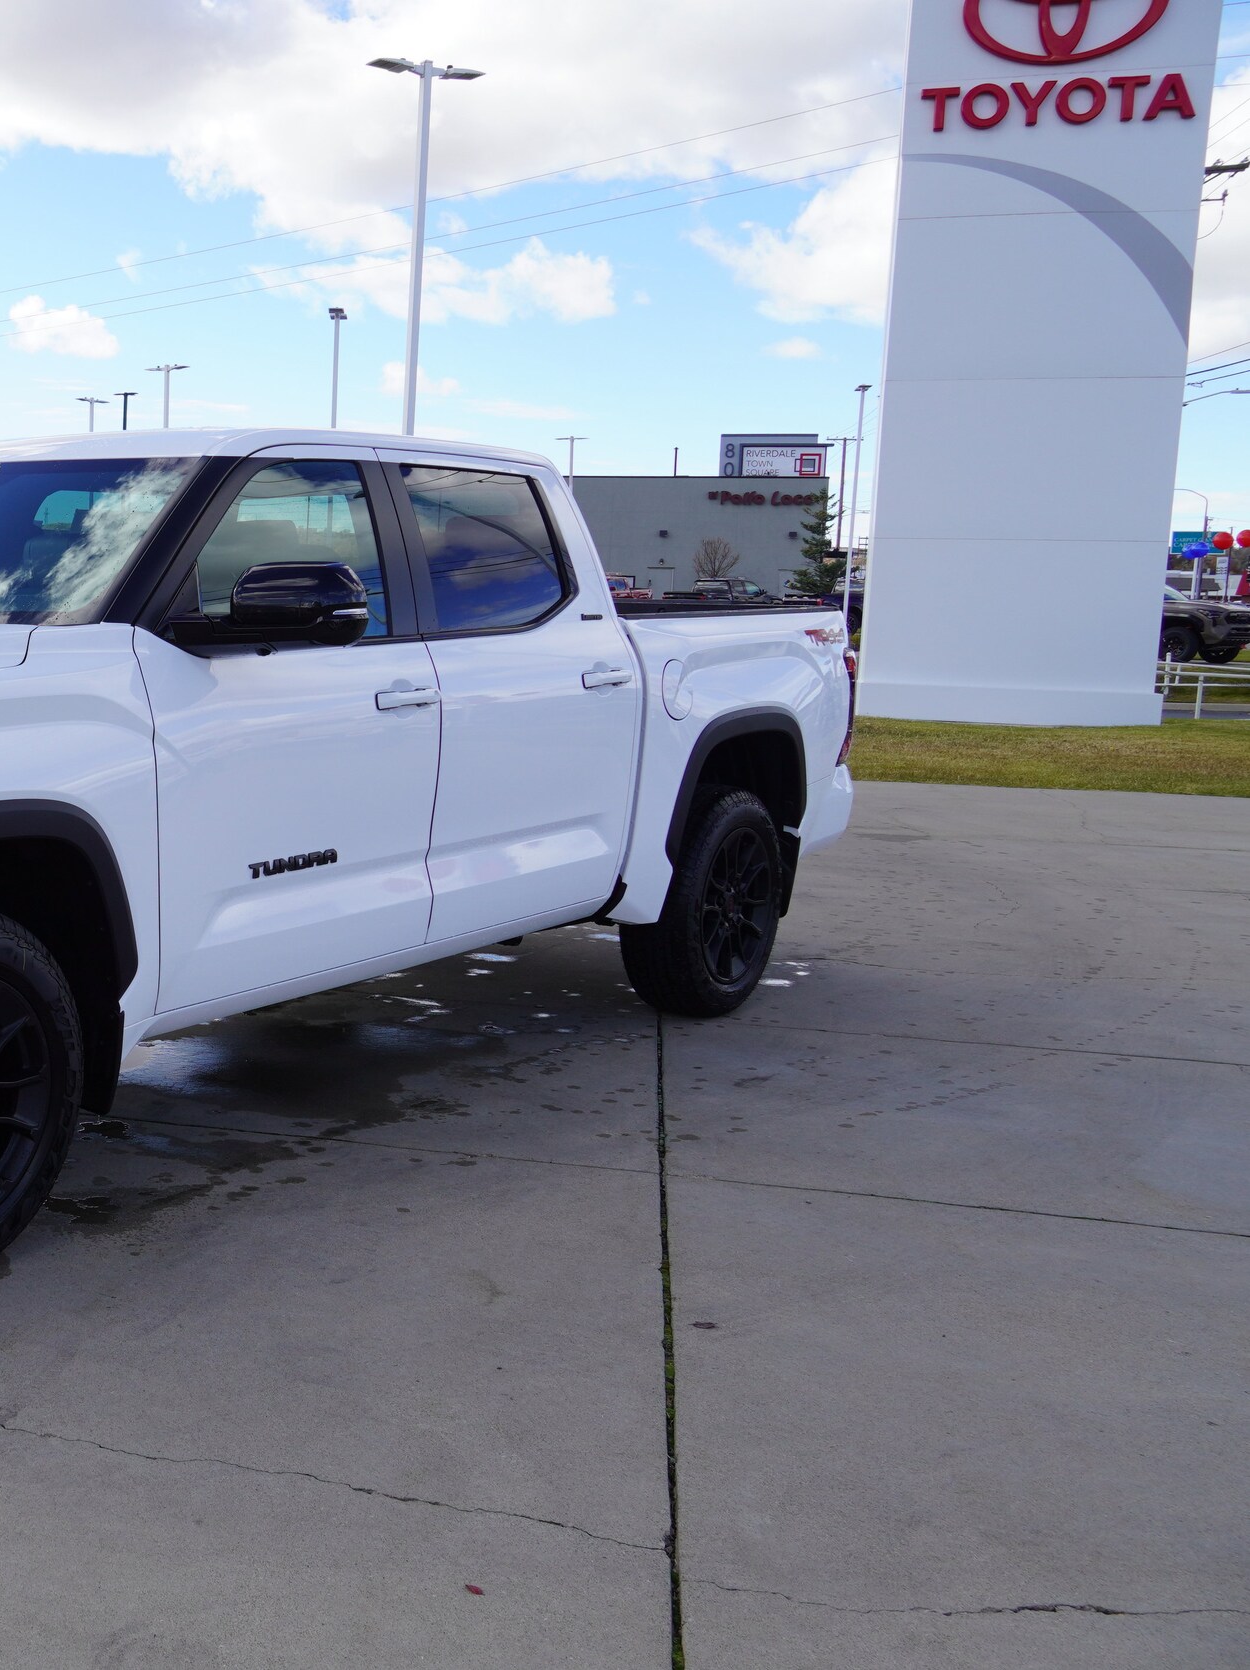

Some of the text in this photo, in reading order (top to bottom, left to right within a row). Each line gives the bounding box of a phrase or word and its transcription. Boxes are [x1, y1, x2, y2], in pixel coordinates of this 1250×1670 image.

[921, 73, 1196, 132] TOYOTA
[745, 449, 797, 459] RIVERDALE
[746, 460, 774, 468] TOWN
[745, 468, 780, 476] SQUARE
[248, 848, 338, 880] TUNDRA
